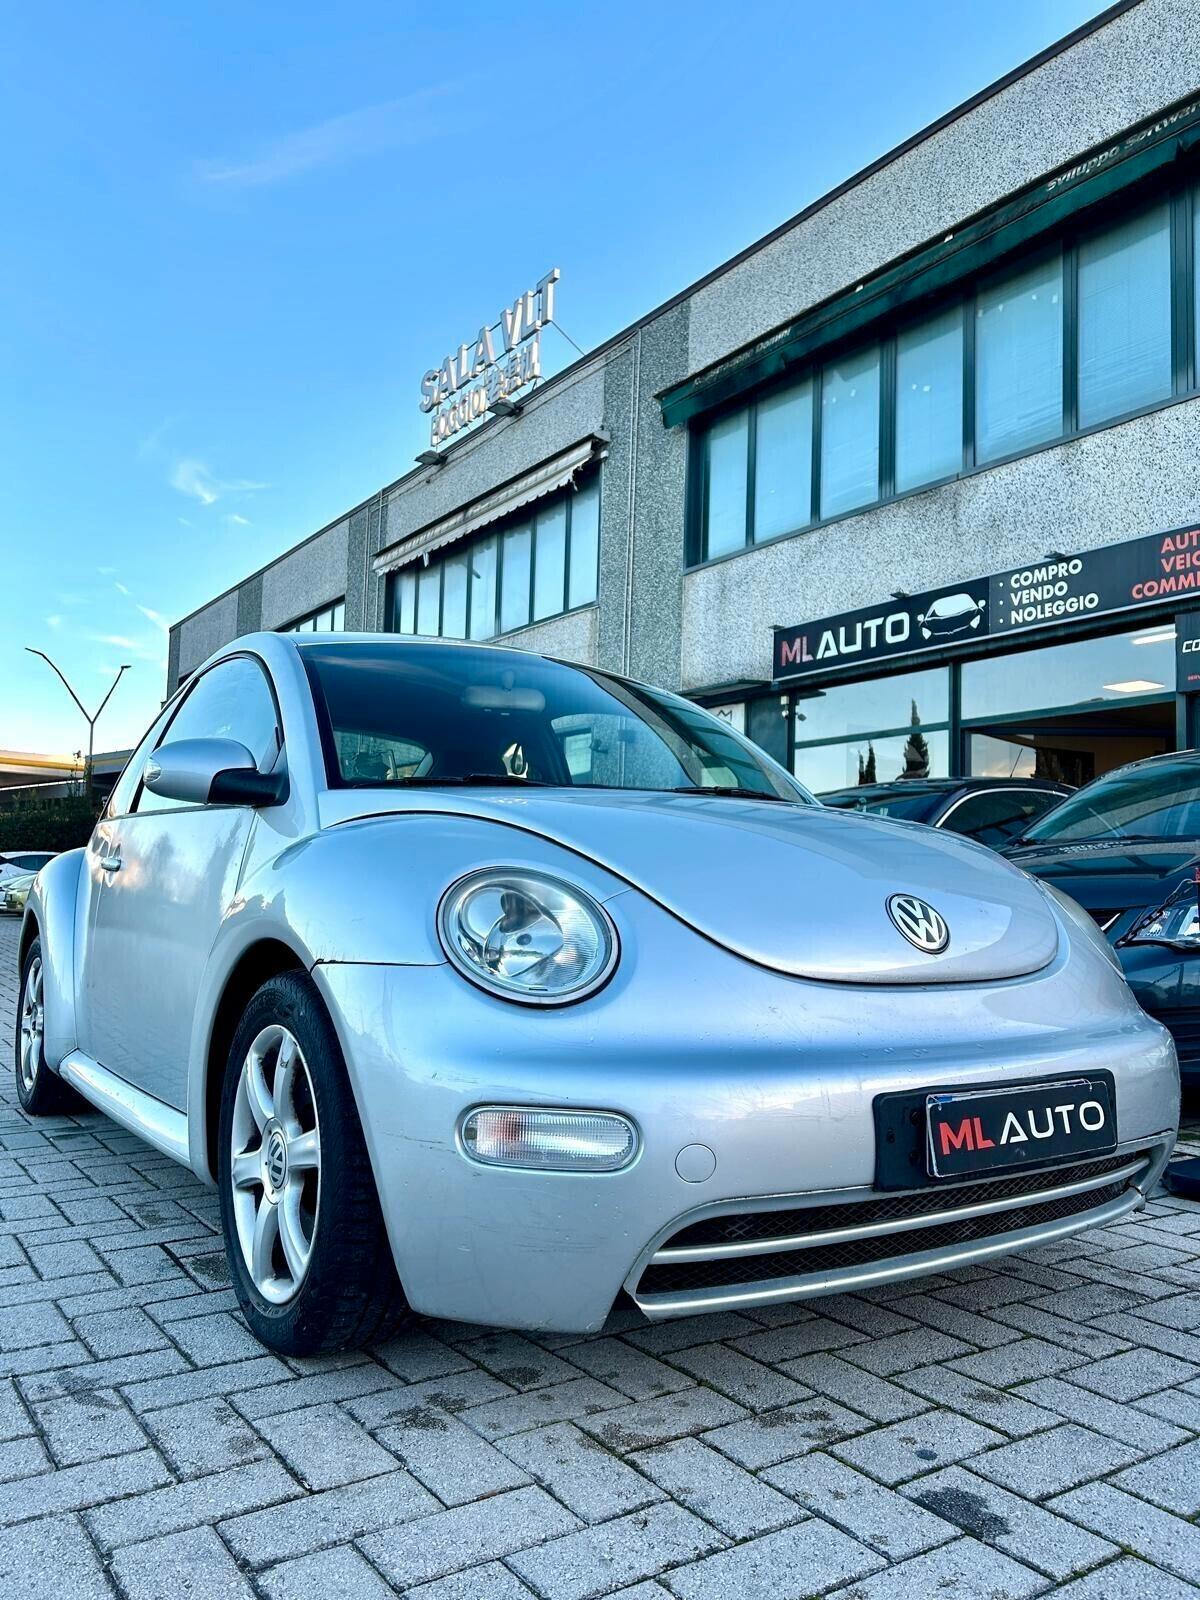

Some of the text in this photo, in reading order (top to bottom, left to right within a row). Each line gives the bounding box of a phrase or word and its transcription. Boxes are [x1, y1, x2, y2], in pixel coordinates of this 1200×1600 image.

[419, 325, 496, 413] SALA
[500, 267, 561, 353] VLT
[1010, 559, 1083, 588] COMPRO
[1010, 581, 1068, 607] VENDO
[1010, 593, 1099, 625] NOLEGGIO
[1000, 1101, 1105, 1145] AUTO
